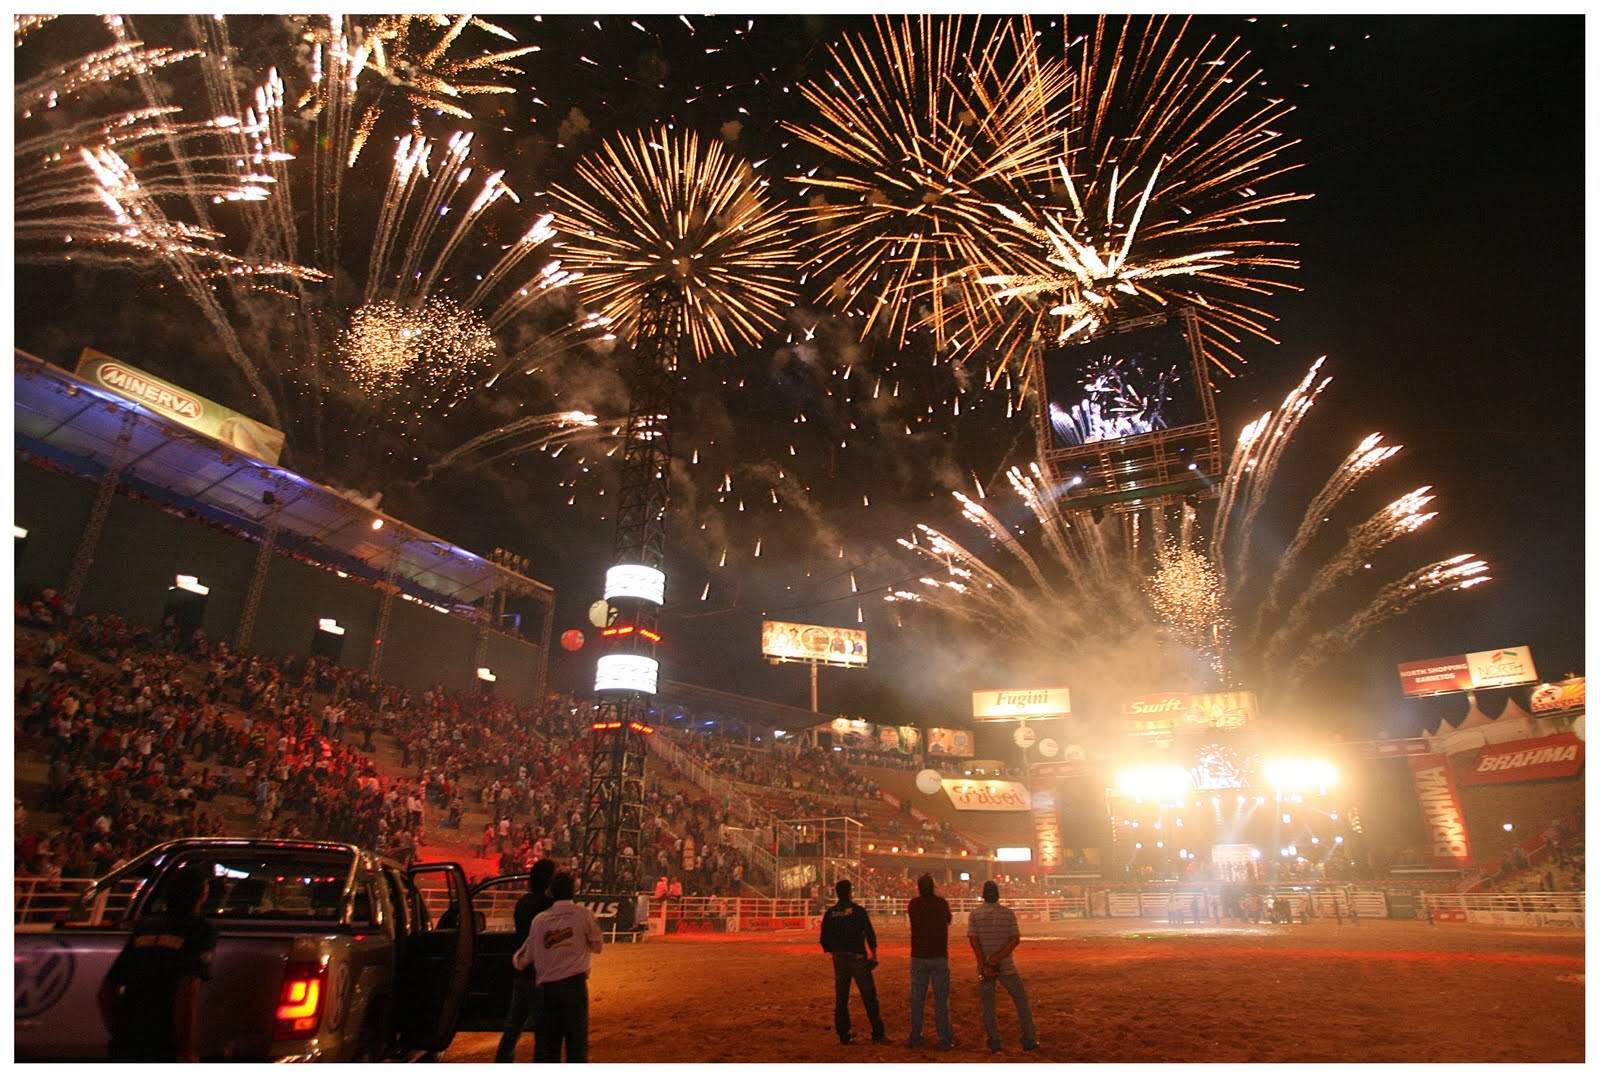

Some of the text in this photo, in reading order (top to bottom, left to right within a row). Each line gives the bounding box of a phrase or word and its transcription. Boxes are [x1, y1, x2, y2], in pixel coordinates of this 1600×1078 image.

[103, 370, 197, 417] MINERVA
[1428, 663, 1468, 674] SHOPPING
[994, 690, 1048, 709] Fugini
[1129, 698, 1186, 714] Swift
[1476, 745, 1578, 773] BRAHMA
[1416, 766, 1468, 857] BRAHMA
